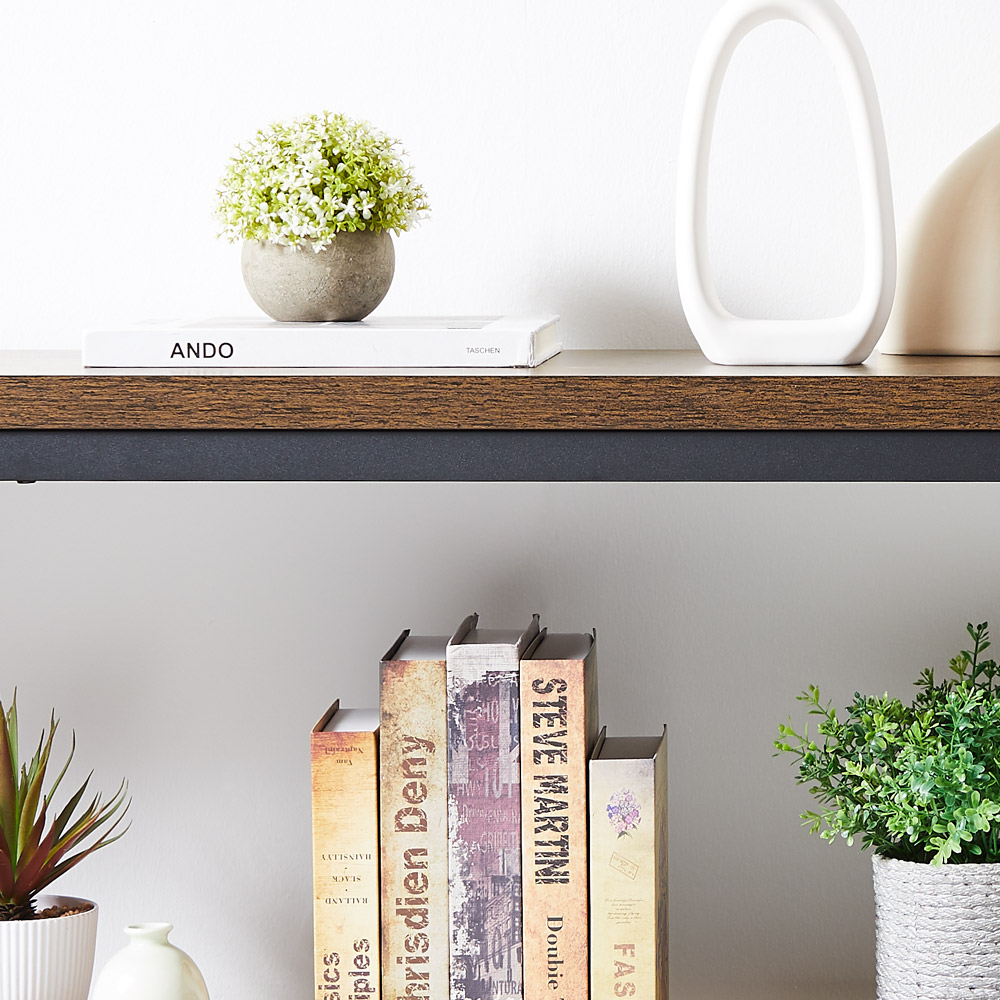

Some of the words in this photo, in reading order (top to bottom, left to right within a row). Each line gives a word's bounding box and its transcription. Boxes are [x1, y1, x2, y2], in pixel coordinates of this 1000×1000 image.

[170, 342, 235, 359] ANDO
[531, 677, 568, 765] STEVE
[394, 734, 436, 833] Deny
[533, 774, 570, 885] MARTINI
